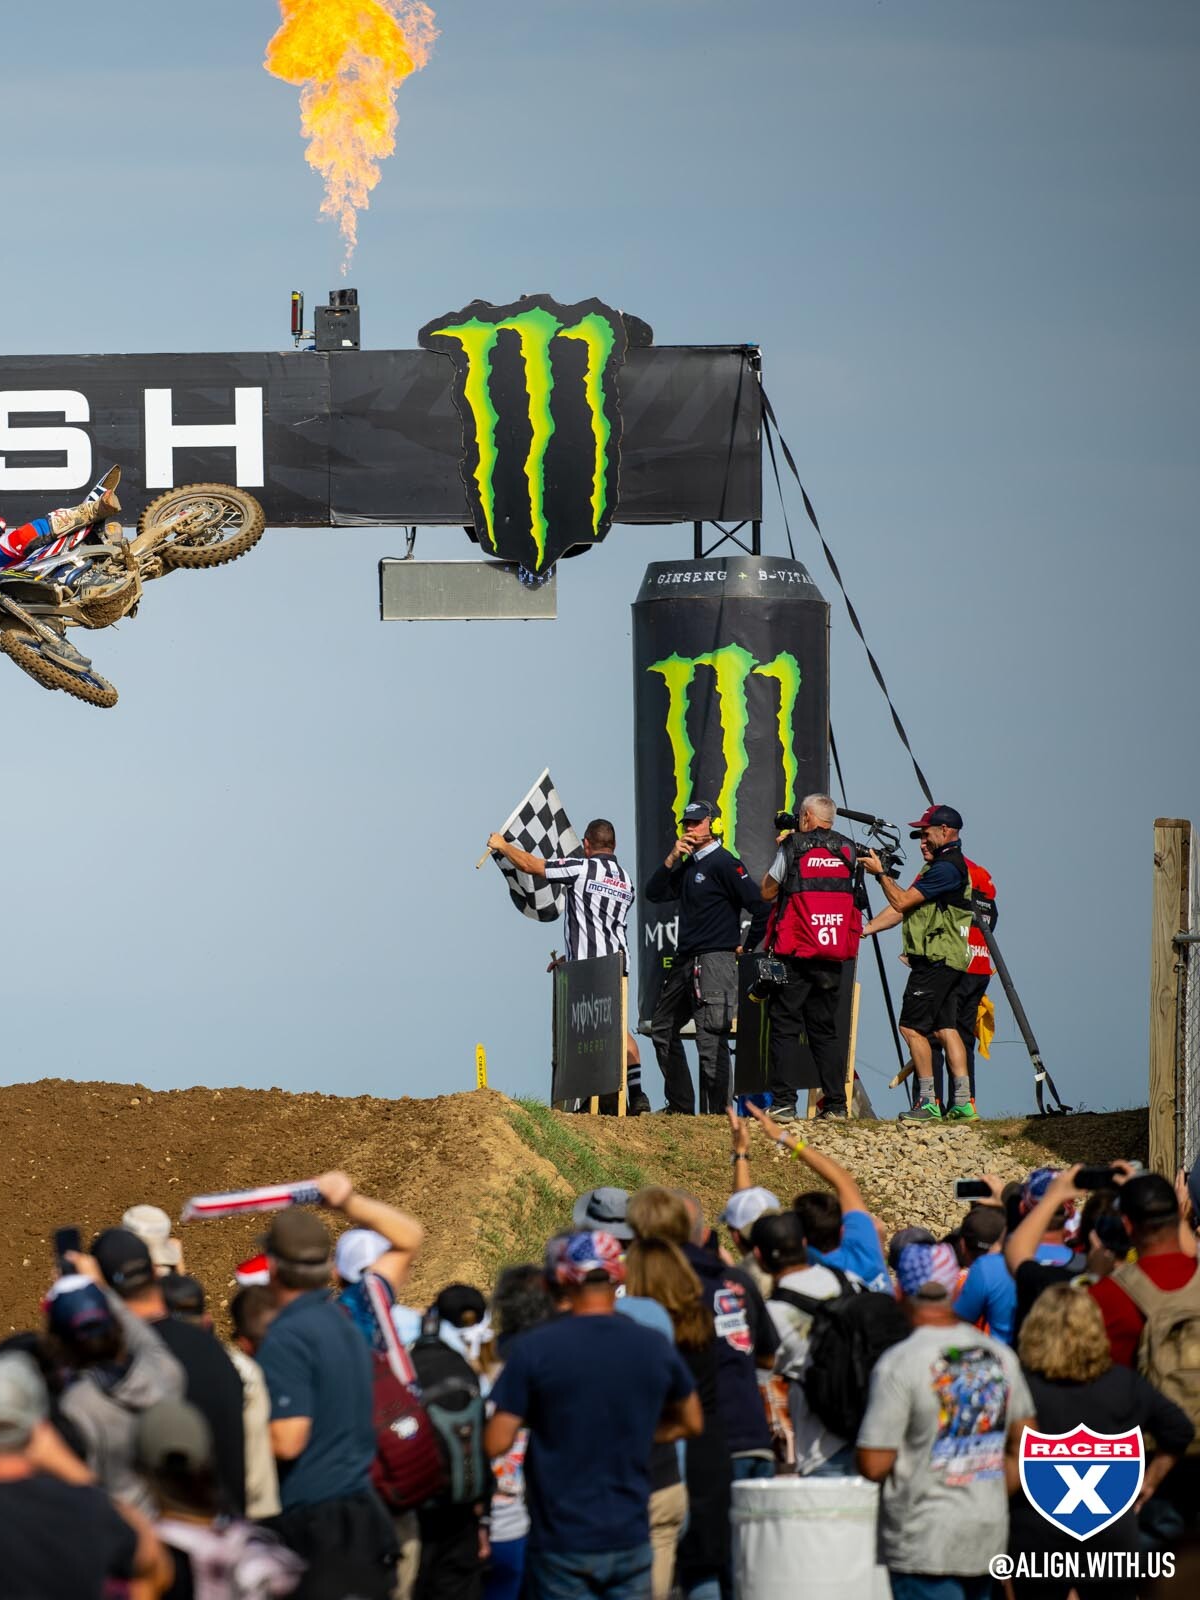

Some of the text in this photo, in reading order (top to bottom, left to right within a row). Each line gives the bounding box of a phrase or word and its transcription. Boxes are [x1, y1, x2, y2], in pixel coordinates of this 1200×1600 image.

[657, 570, 728, 584] GINSENG
[602, 877, 619, 888] LUCAS
[810, 913, 843, 926] STAFF
[817, 926, 838, 946] 61
[570, 992, 613, 1035] MONSTER
